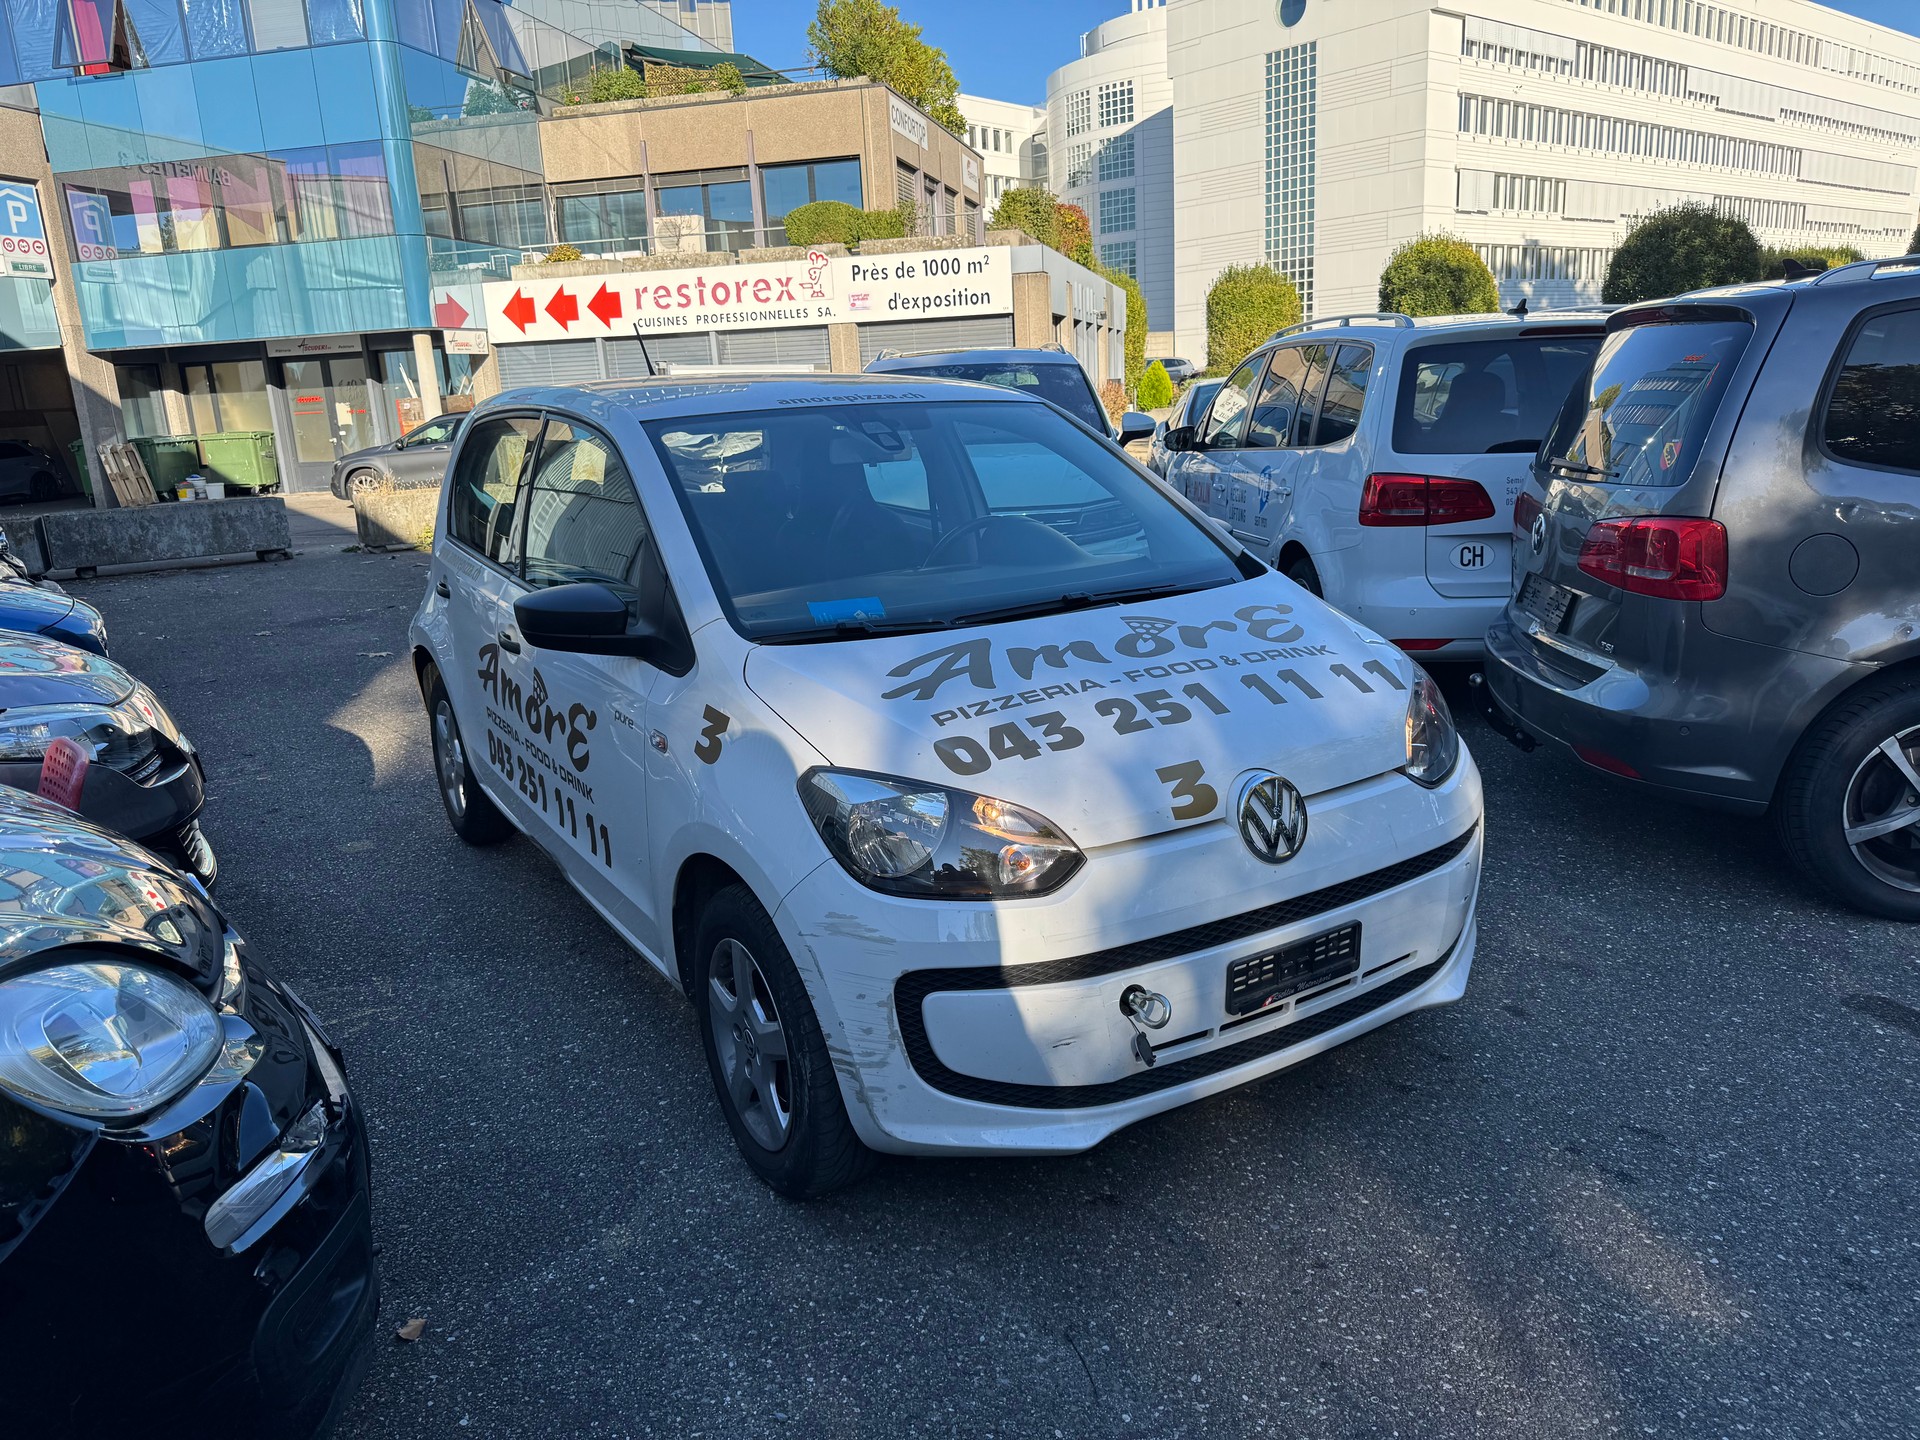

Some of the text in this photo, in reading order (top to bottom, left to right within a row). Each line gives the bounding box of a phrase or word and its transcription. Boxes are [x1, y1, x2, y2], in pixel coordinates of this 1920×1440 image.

[6, 200, 28, 234] P
[852, 262, 888, 281] Près
[896, 261, 915, 278] de
[923, 258, 961, 276] 1000
[635, 276, 796, 310] restorex
[888, 288, 991, 313] d'exposition
[637, 307, 836, 328] CUISINES PROFESSIONNELLES SA.
[777, 392, 925, 405] amorepizza.ch
[1460, 547, 1484, 568] CH
[930, 679, 1106, 727] PIZZERIA
[1123, 657, 1218, 682] FOOD
[1218, 655, 1241, 666] &
[1240, 645, 1339, 663] DRINK
[614, 709, 634, 730] pure
[693, 703, 730, 765] 3
[934, 659, 1407, 776] 043 251 11 11
[486, 706, 521, 746] PIZZERIA
[524, 737, 551, 769] FOOD
[559, 764, 595, 805] DRINK
[487, 728, 612, 869] 043 251 11 11
[1155, 760, 1219, 820] 3
